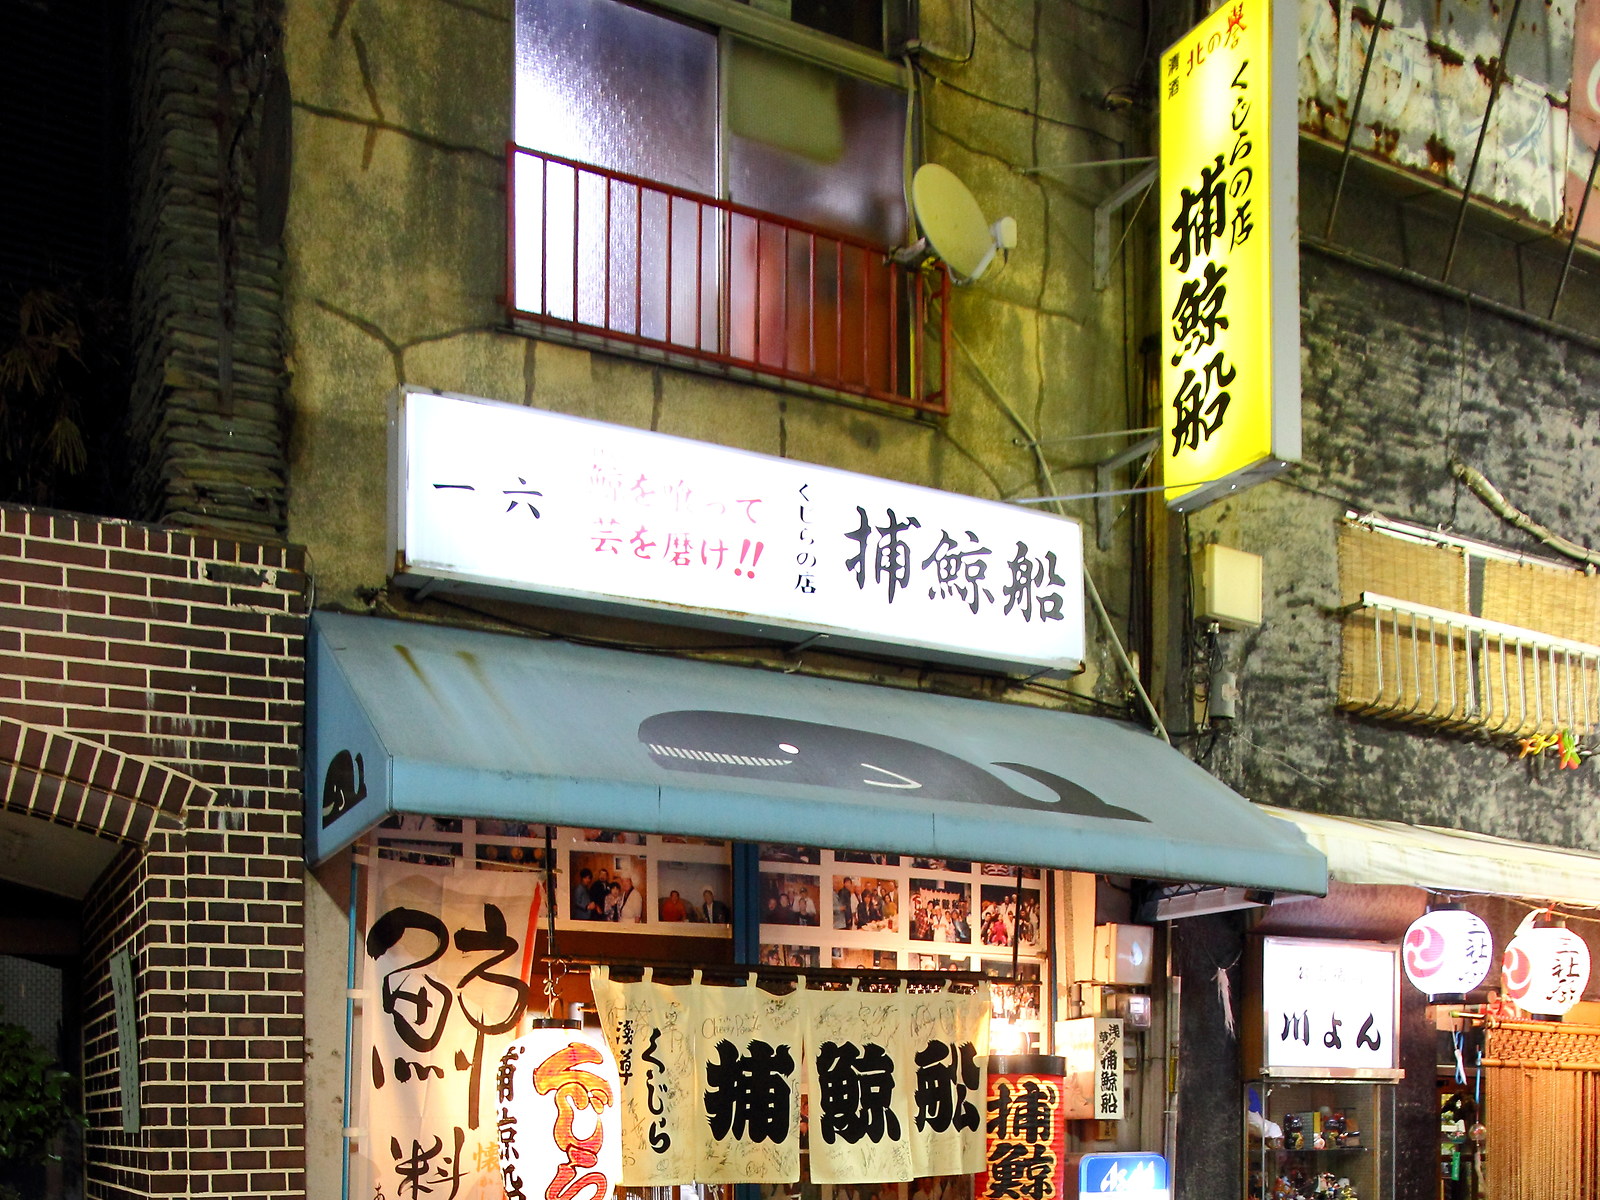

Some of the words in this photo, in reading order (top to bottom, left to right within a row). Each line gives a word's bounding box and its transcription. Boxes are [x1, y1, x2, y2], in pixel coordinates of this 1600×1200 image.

[1229, 59, 1254, 253] くじらの店
[1170, 155, 1236, 457] 捕鯨船
[432, 477, 543, 519] 一六
[795, 483, 816, 594] くじらの店
[845, 504, 1065, 622] 捕鯨船
[642, 1027, 671, 1154] くじら
[703, 1038, 980, 1145] 捕鯨船
[1101, 1049, 1118, 1114] 捕鯨船
